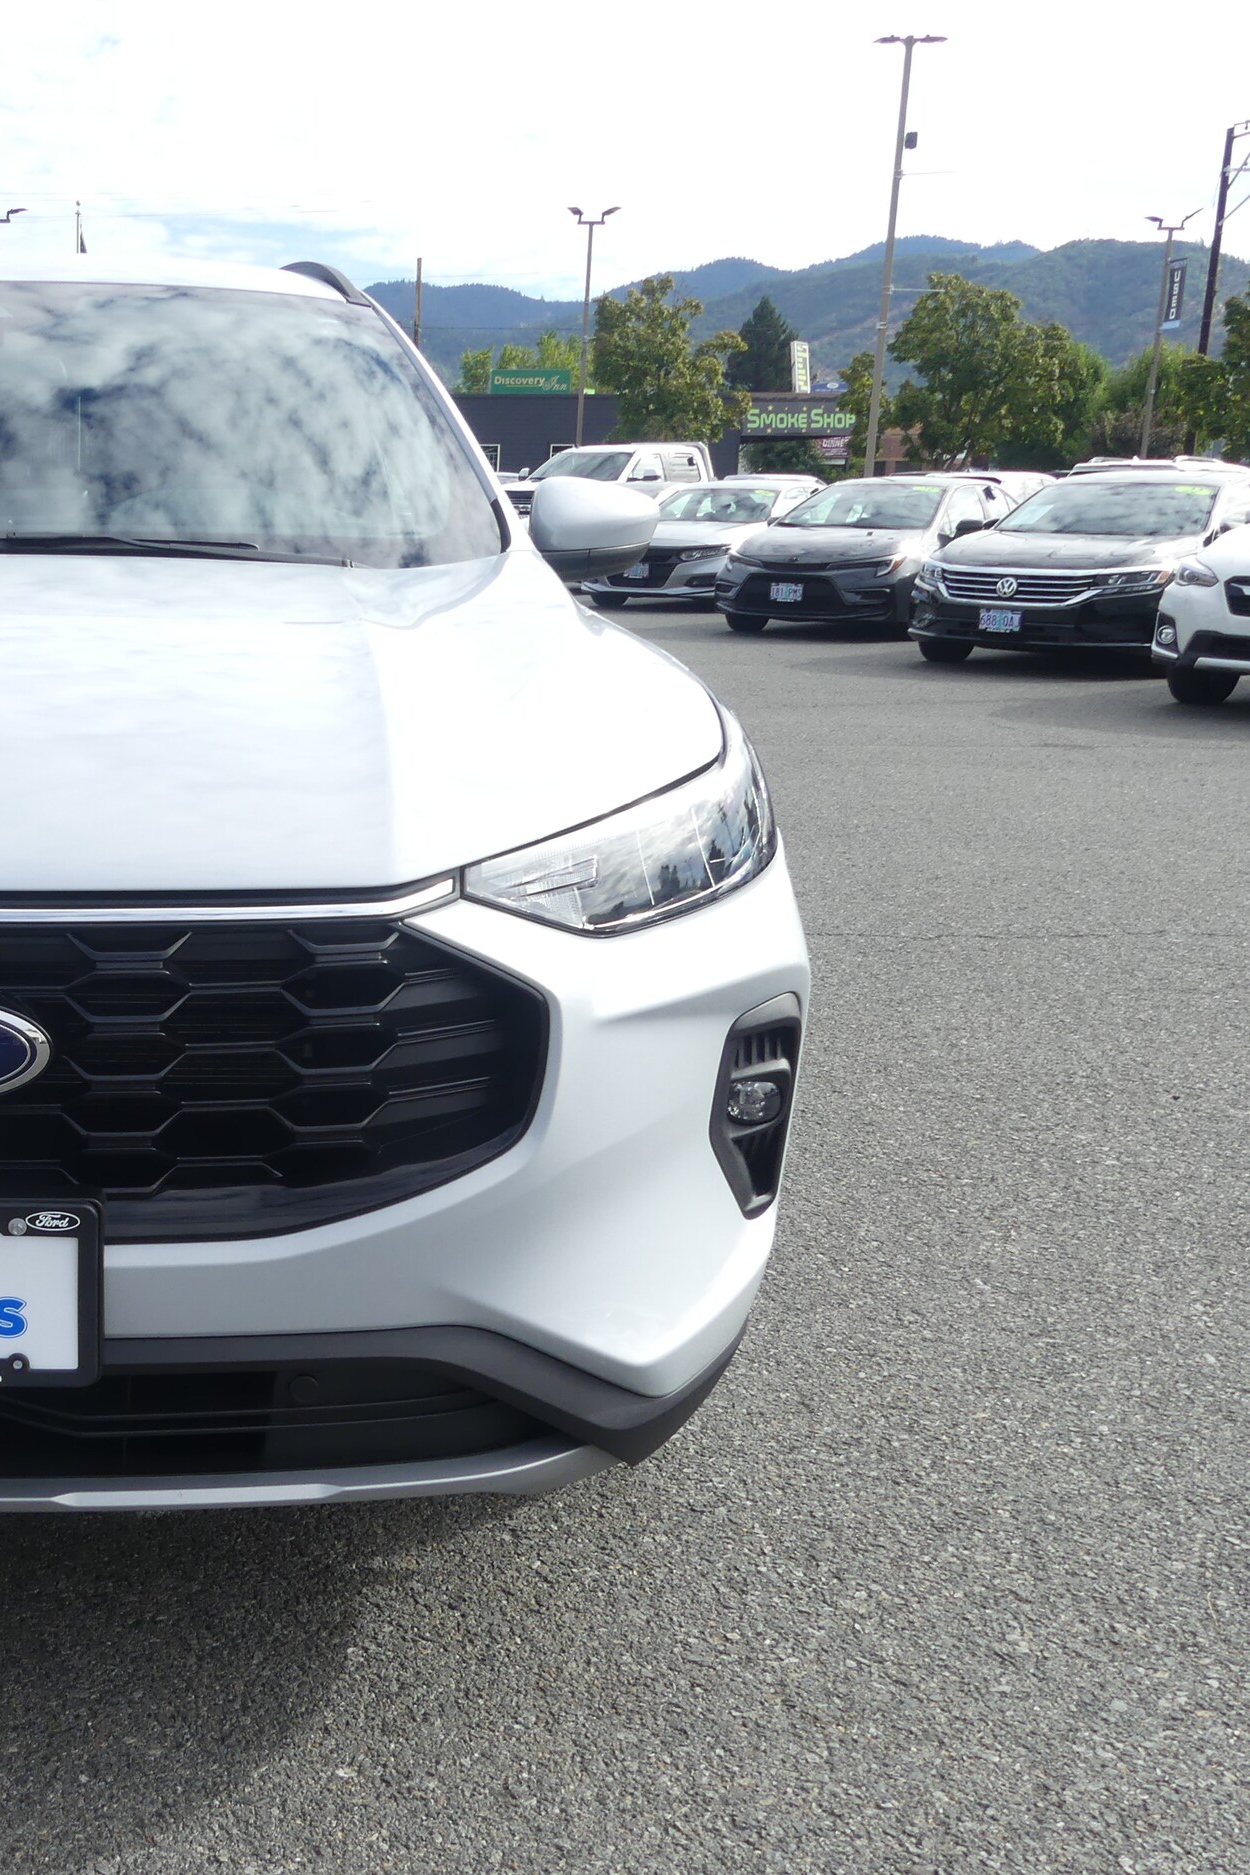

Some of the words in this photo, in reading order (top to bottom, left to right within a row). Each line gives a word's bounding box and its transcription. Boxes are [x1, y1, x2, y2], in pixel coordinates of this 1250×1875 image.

[1168, 270, 1182, 320] USED
[542, 375, 568, 391] Inn
[980, 614, 997, 626] 688
[34, 1213, 70, 1229] Ford
